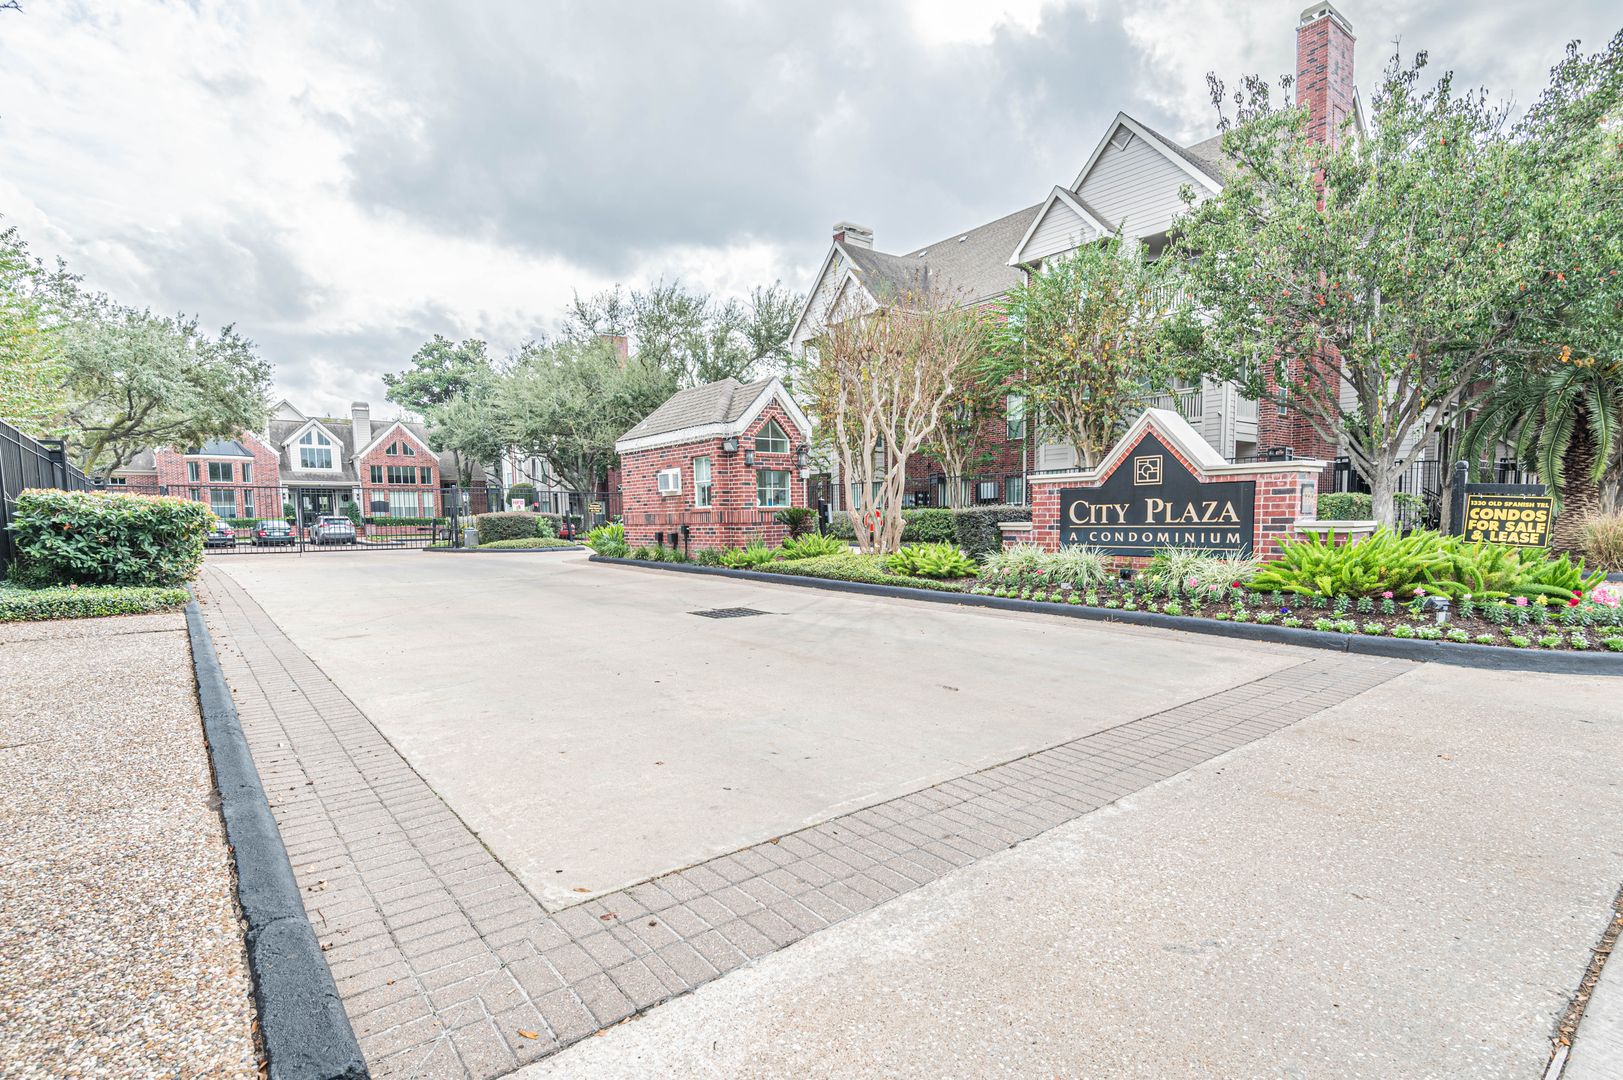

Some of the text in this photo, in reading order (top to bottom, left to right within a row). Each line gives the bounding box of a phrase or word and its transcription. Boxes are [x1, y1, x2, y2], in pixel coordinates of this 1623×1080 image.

[1069, 498, 1241, 524] CITY PLAZA
[1470, 508, 1547, 522] CONDOS
[1468, 520, 1546, 533] FOR SALE
[1069, 532, 1241, 544] A CONDOMINIUM
[1471, 530, 1540, 544] & LEASE
